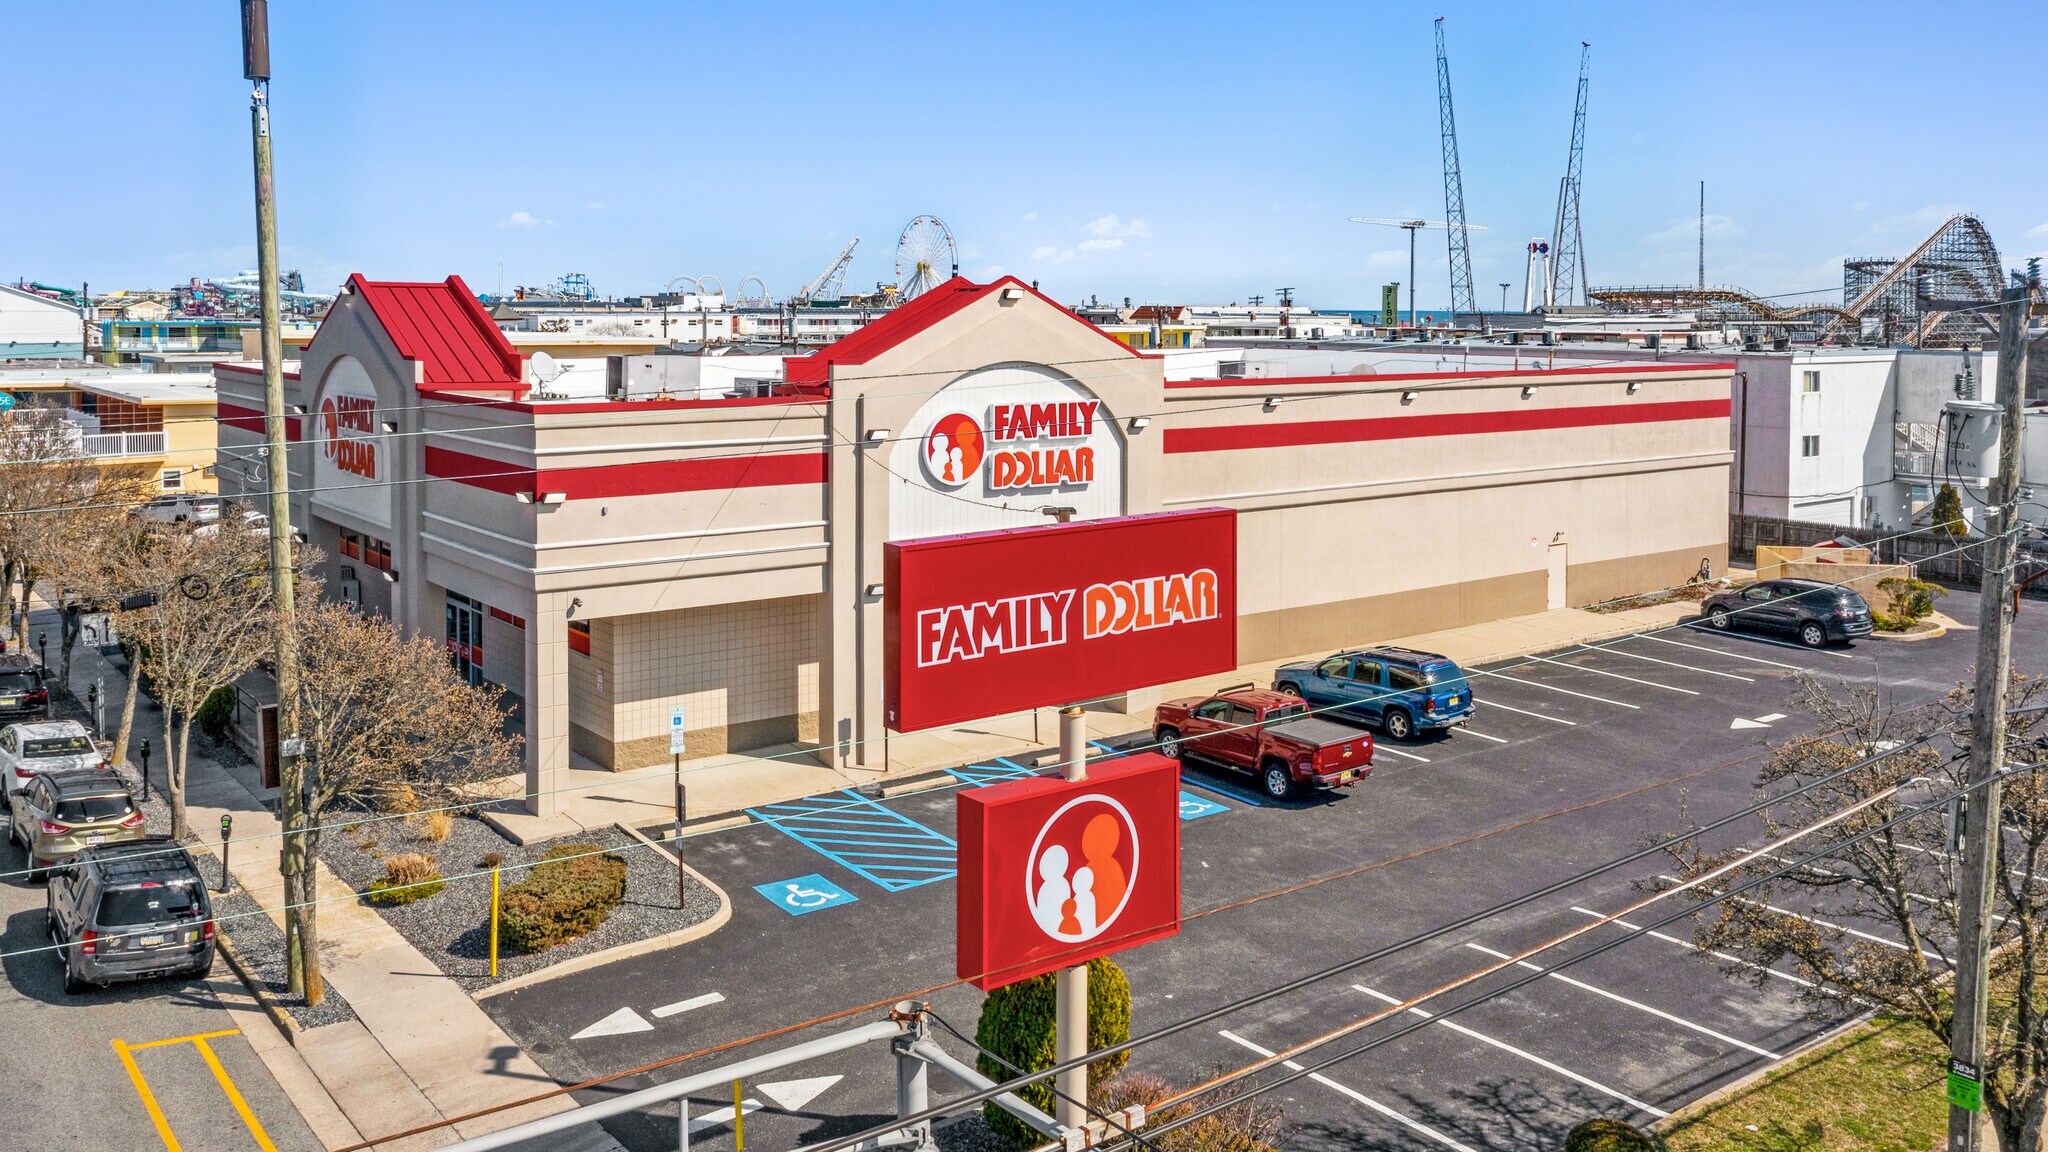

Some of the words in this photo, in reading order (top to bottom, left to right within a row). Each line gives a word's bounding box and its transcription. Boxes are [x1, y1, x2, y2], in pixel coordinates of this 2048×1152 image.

[337, 395, 376, 433] FAMILY
[994, 401, 1099, 440] FAMILY
[337, 439, 376, 480] DOLLAR
[993, 447, 1094, 488] DOLLAR
[917, 588, 1077, 668] FAMILY
[1083, 568, 1218, 640] DOLLAR
[1953, 1062, 1976, 1076] 3834
